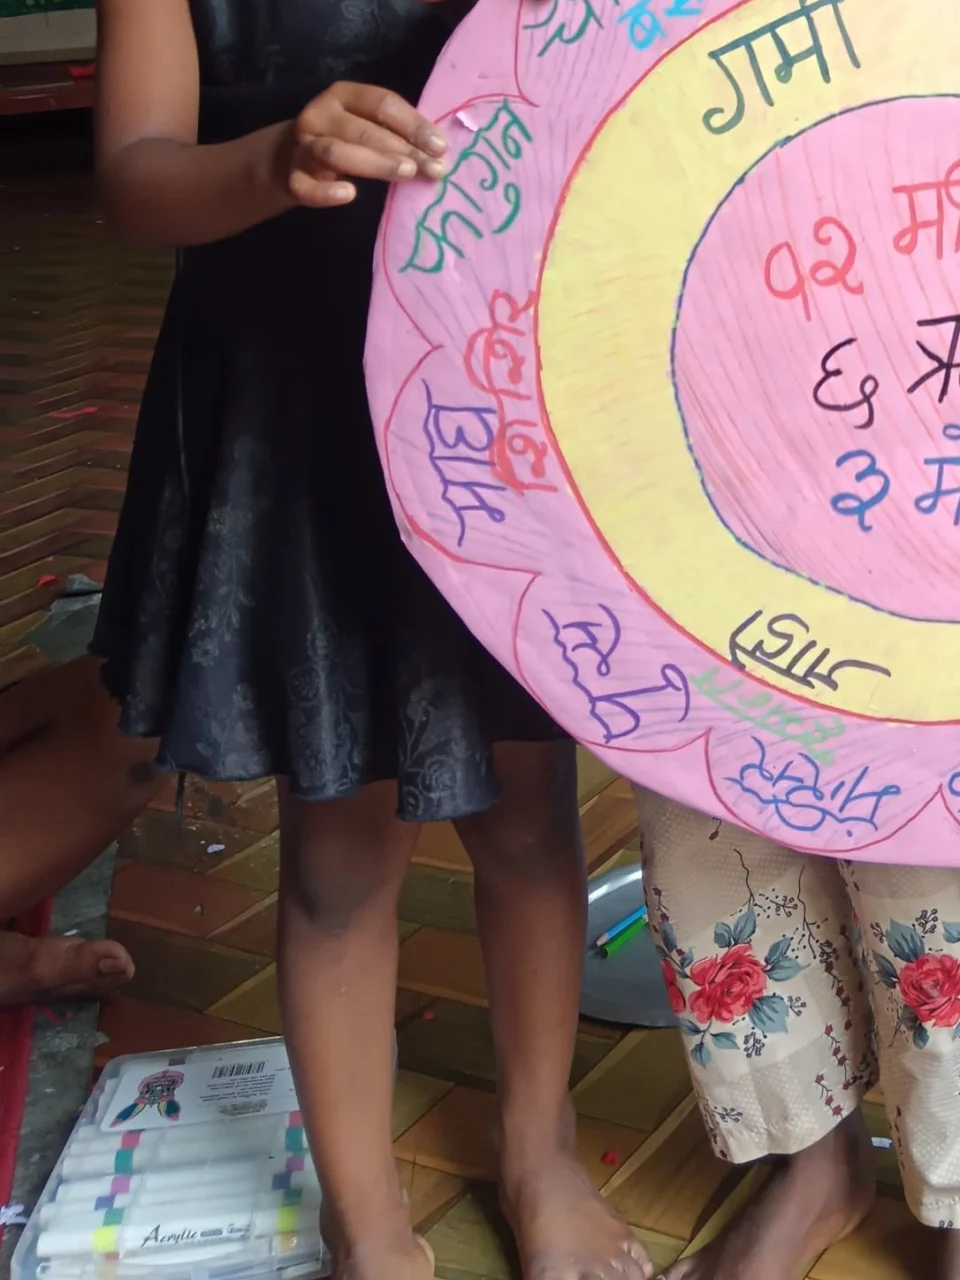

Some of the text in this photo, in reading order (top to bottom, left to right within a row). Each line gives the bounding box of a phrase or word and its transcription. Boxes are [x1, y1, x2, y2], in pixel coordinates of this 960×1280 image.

[764, 216, 864, 322] १२
[421, 378, 507, 547] माघ
[831, 449, 891, 532] ३
[729, 609, 892, 692] जाडो
[141, 1223, 198, 1248] Acrylic
